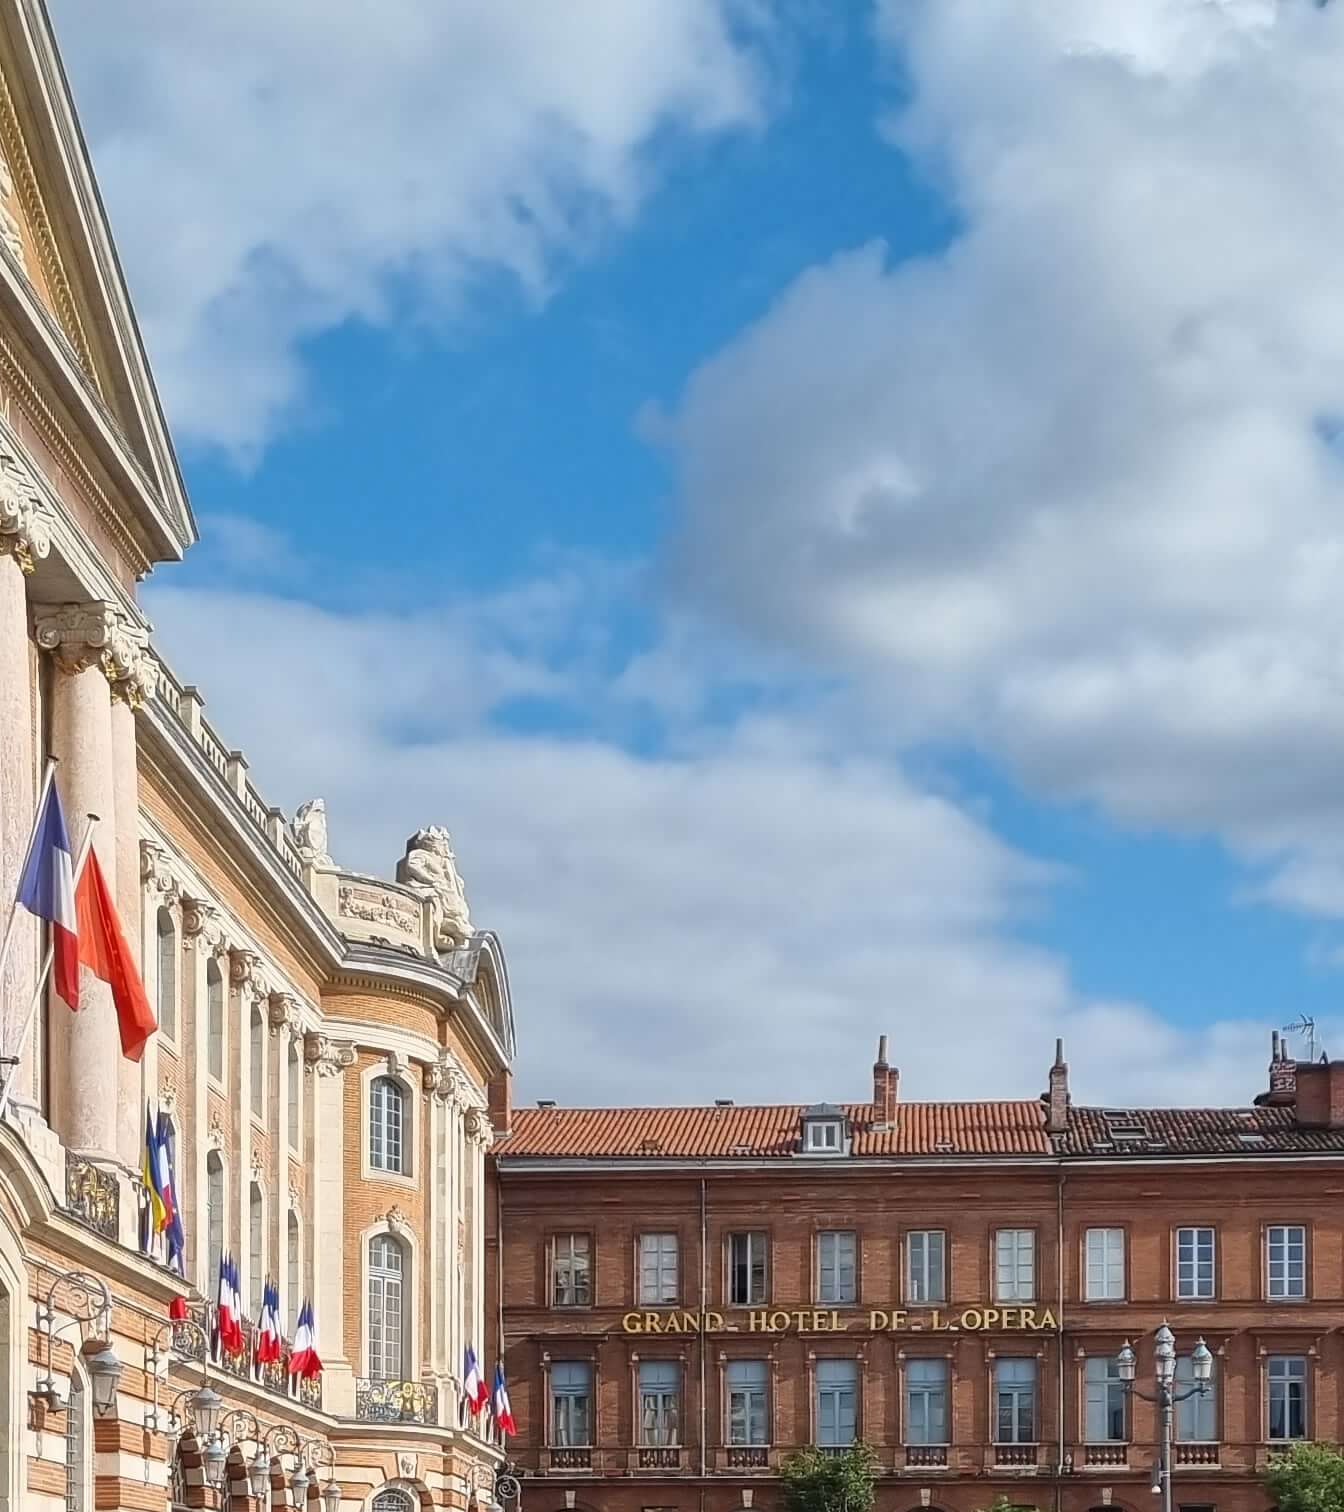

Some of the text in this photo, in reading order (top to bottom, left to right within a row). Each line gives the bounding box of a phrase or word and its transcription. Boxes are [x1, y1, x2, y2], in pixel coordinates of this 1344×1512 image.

[622, 1312, 724, 1332] GRAND
[750, 1311, 848, 1332] HOTEL
[869, 1310, 907, 1331] DE
